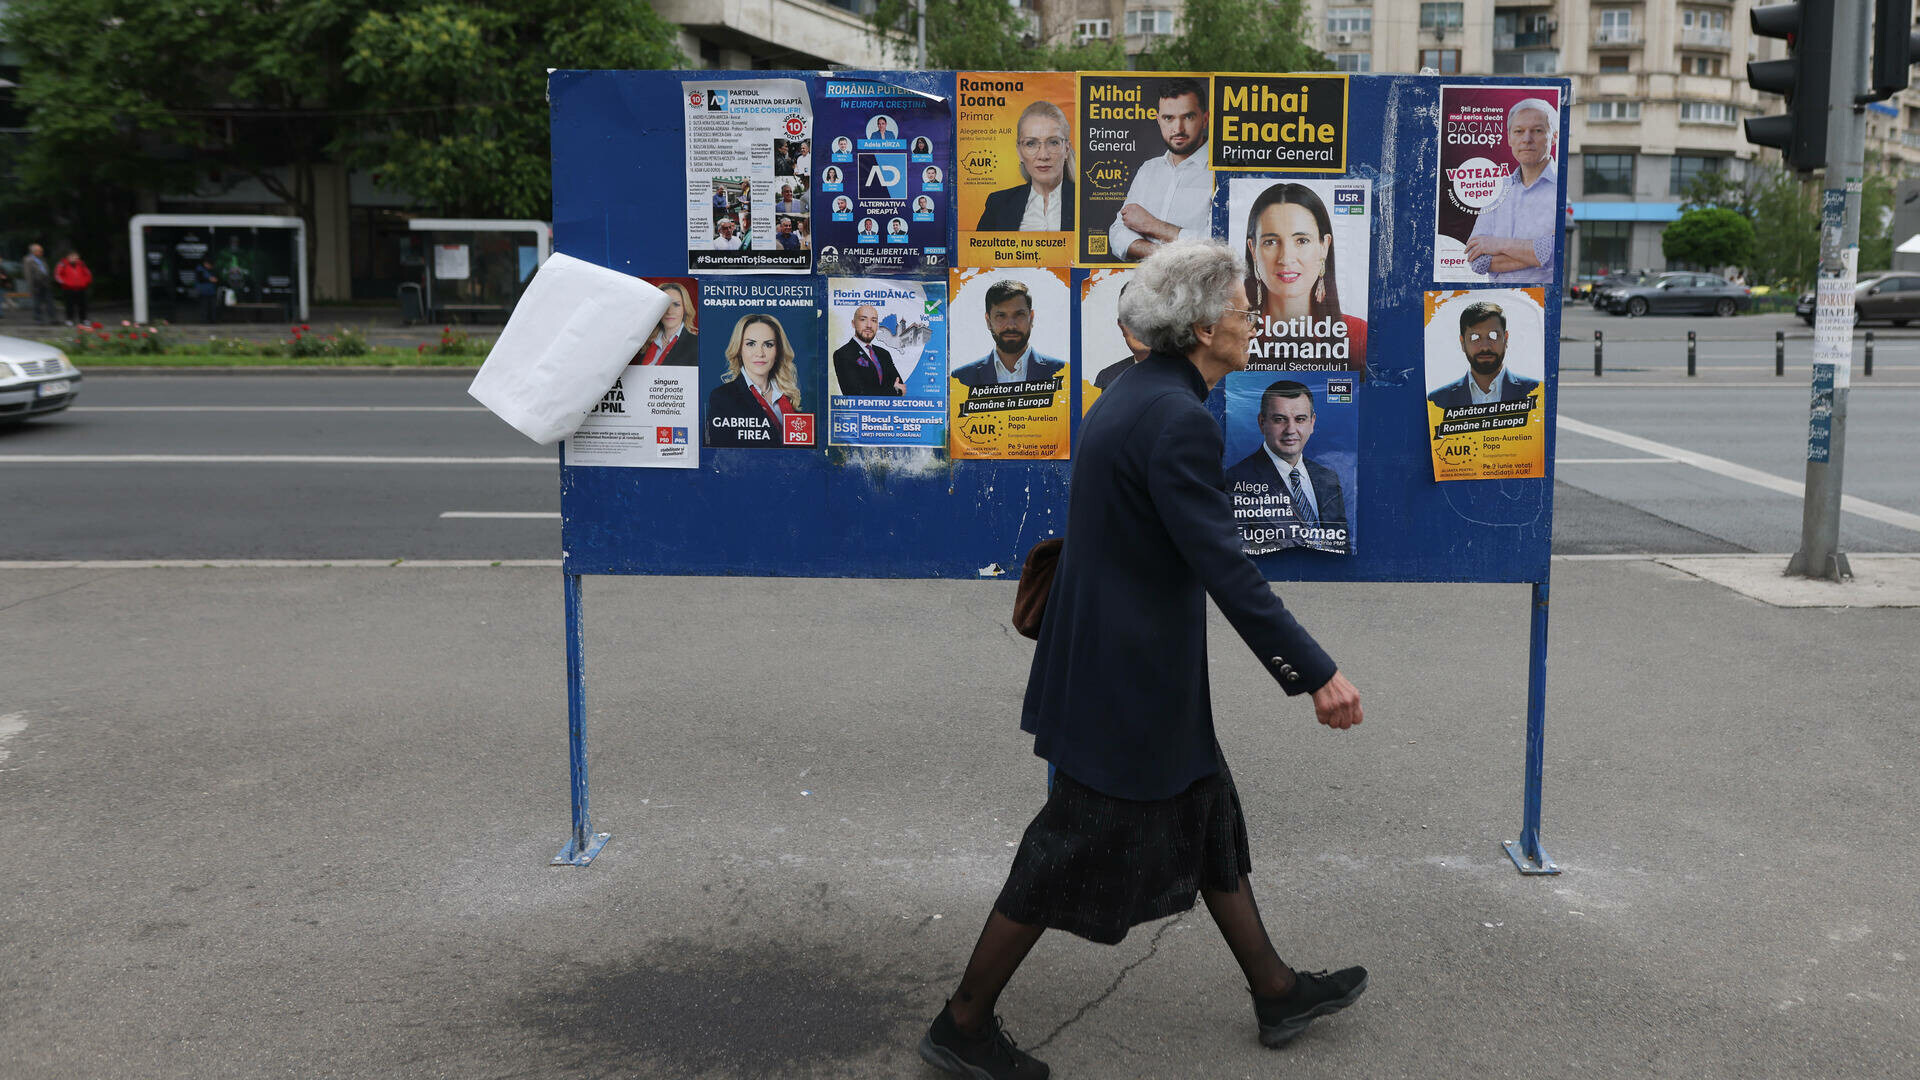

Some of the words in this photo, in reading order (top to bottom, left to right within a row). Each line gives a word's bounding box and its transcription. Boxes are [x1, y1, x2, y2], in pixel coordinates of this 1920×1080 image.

[827, 82, 876, 95] ROMÂNIA
[960, 78, 1024, 92] Ramona
[1089, 84, 1142, 101] Mihai
[691, 96, 701, 104] 10
[774, 97, 803, 105] DREAPTĂ
[840, 99, 849, 108] ÎN
[851, 100, 884, 109] EUROPA
[886, 99, 927, 110] CREȘTINĂ
[960, 93, 1006, 107] Ioana
[1223, 85, 1309, 113] Mihai
[960, 111, 994, 121] Primar
[1089, 103, 1158, 120] Enache
[789, 122, 801, 132] 10
[1222, 116, 1335, 144] Enache
[1447, 121, 1504, 133] DACIAN
[1089, 127, 1130, 139] Primar
[1089, 140, 1136, 152] General
[1447, 133, 1503, 149] CIOLOȘ?
[1223, 146, 1272, 160] Primar
[1276, 147, 1333, 161] General
[969, 158, 992, 167] AUR
[1096, 169, 1122, 180] AUR
[1446, 163, 1510, 180] VOTEAZĂ
[1460, 180, 1496, 189] Partidul
[1464, 190, 1493, 199] reper
[866, 207, 899, 215] DREAPTĂ
[970, 237, 1019, 249] Rezultate,
[1021, 239, 1033, 247] nu
[1035, 237, 1066, 247] scuze!
[843, 248, 875, 256] FAMILIE,
[876, 248, 920, 256] LIBERTATE,
[995, 250, 1014, 260] Bun
[1015, 250, 1042, 263] Simț.
[697, 255, 806, 265] #SuntemToțiSectorul1
[859, 256, 905, 264] DEMNITATE.
[926, 254, 938, 265] 10
[1440, 257, 1466, 266] reper
[704, 286, 748, 296] PENTRU
[751, 286, 813, 299] BUCUREȘTI
[833, 290, 861, 299] Florin
[703, 299, 737, 308] ORAȘUL
[738, 299, 764, 307] DORIT
[779, 299, 814, 307] OAMENI
[1255, 315, 1348, 338] Clotilde
[1247, 337, 1350, 359] Armand
[1244, 362, 1286, 371] primarul
[1288, 361, 1341, 371] Sectorului
[653, 378, 679, 386] singura
[971, 386, 1013, 396] Apărător
[1025, 381, 1055, 392] Patriei
[649, 393, 684, 401] moderniza
[600, 402, 626, 413] PNL
[834, 399, 856, 408] UNIȚI
[858, 399, 890, 407] PENTRU
[892, 399, 935, 408] SECTORUL
[968, 401, 1005, 411] Române
[1007, 399, 1016, 407] în
[1018, 398, 1050, 409] Europa
[1446, 405, 1487, 418] Apărător
[1499, 400, 1530, 410] Patriei
[712, 417, 771, 428] GABRIELA
[861, 415, 891, 423] Blocul
[893, 416, 943, 424] Suveranist
[1443, 421, 1480, 432] Române
[1481, 419, 1491, 428] în
[1492, 417, 1524, 427] Europa
[834, 422, 858, 433] BSR
[970, 424, 996, 434] AUR
[737, 430, 771, 440] FIREA
[789, 432, 808, 442] PSD
[1482, 434, 1533, 442] Ioan-Aurelian
[1445, 446, 1471, 456] AUR
[1233, 481, 1269, 494] Alege
[1234, 493, 1290, 506] România
[1289, 524, 1347, 540] Tomac
